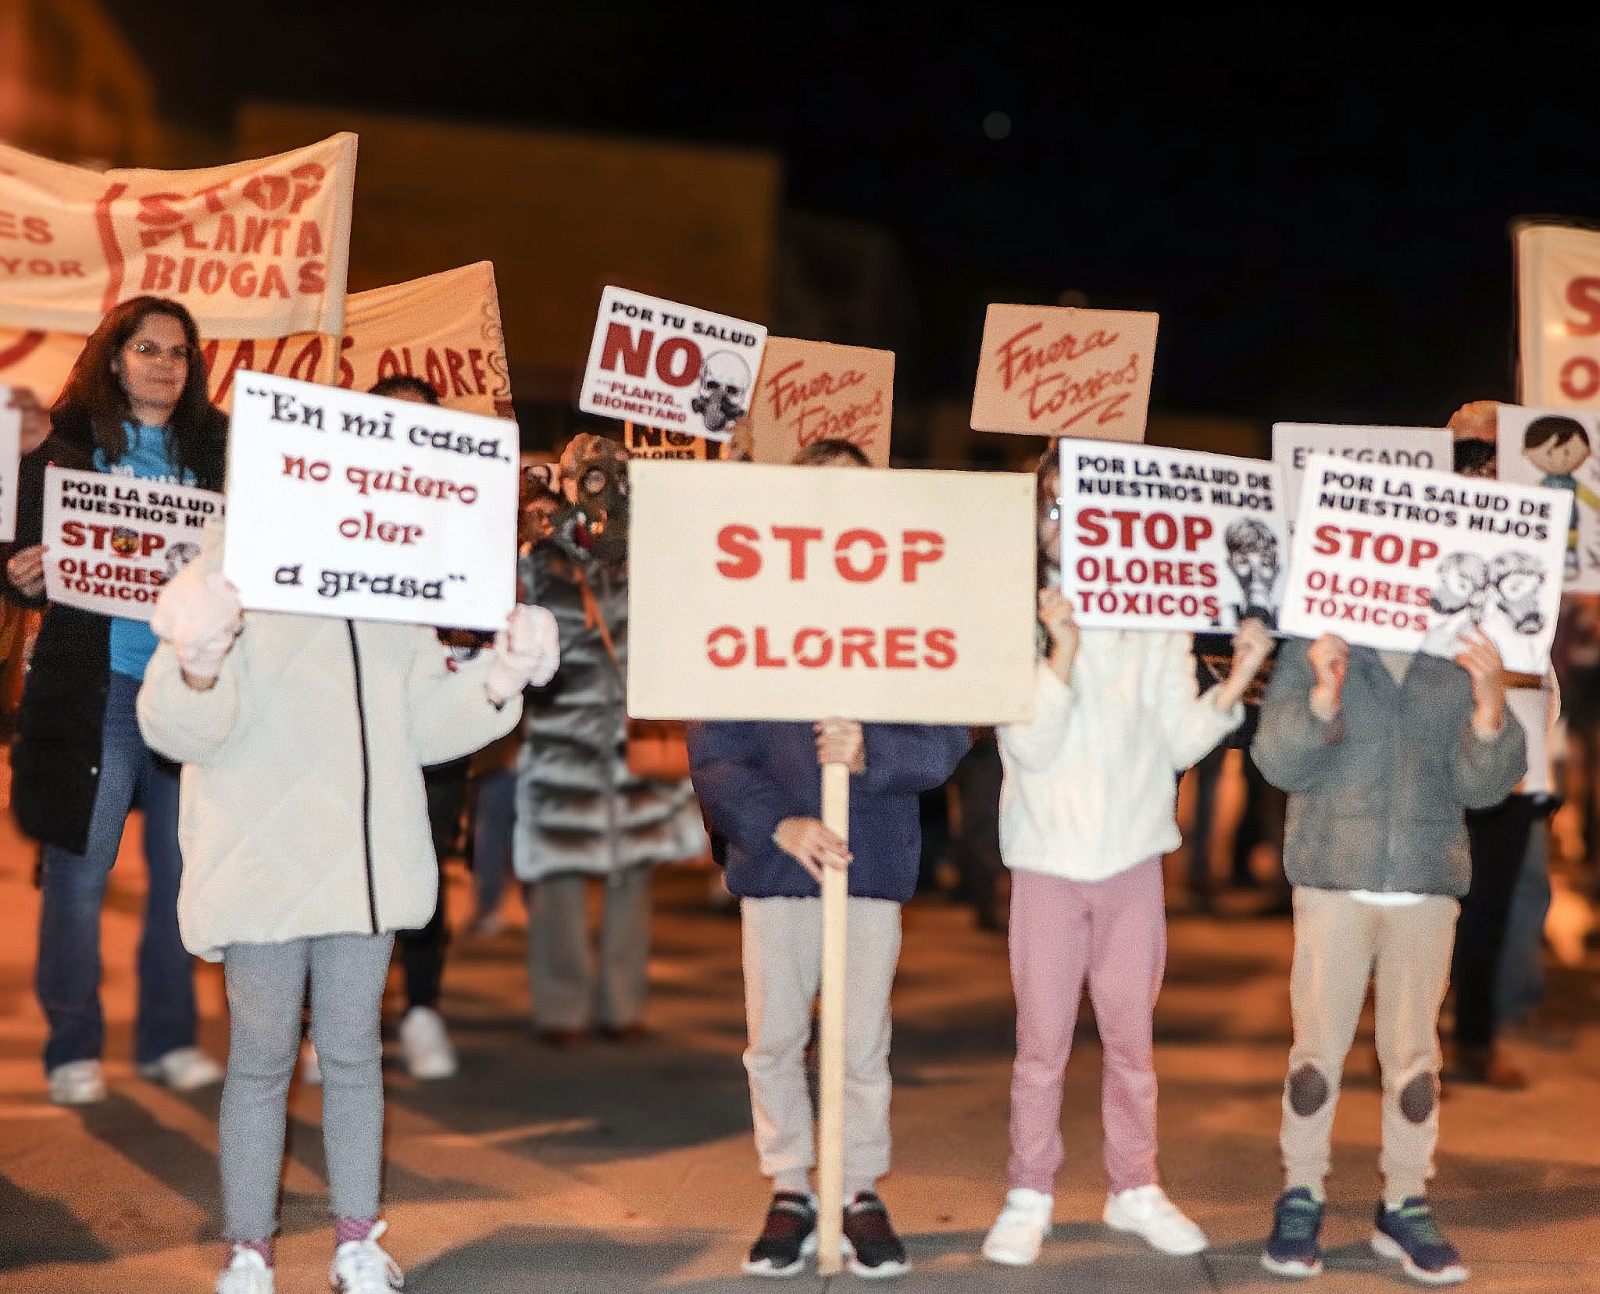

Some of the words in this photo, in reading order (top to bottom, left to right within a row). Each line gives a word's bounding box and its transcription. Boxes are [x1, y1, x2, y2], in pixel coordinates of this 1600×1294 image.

[136, 162, 326, 226] STOP
[139, 214, 323, 257] PLANTA
[140, 253, 326, 299] BIOGAS
[611, 302, 653, 322] POR
[660, 312, 686, 330] TU
[692, 321, 758, 348] SALUD
[600, 321, 704, 388] NO
[341, 411, 394, 440] mi
[592, 393, 688, 423] BIOMETANO
[282, 453, 331, 482] no
[346, 466, 479, 505] quiero
[1078, 456, 1126, 474] POR
[1134, 460, 1161, 478] LA
[1169, 463, 1240, 486] SALUD
[1247, 472, 1272, 491] DE
[61, 479, 107, 498] POR
[115, 486, 141, 502] LA
[148, 491, 215, 514] SALUD
[62, 496, 179, 525] NUESTROS
[1078, 477, 1203, 502] NUESTROS
[1211, 489, 1274, 511] HIJOS
[1322, 471, 1374, 493] POR
[1383, 479, 1413, 499] LA
[1424, 484, 1510, 513] SALUD
[1519, 501, 1552, 520] DE
[339, 510, 424, 545] oler
[1077, 507, 1214, 553] STOP
[1318, 492, 1458, 528] NUESTROS
[1468, 514, 1550, 541] HIJOS
[61, 519, 166, 558] STOP
[715, 523, 946, 584] STOP
[1313, 524, 1440, 568] STOP
[58, 557, 164, 587] OLORES
[274, 563, 304, 587] a
[1076, 556, 1218, 588] OLORES
[1306, 570, 1432, 608] OLORES
[1077, 584, 1220, 618] TÓXICOS
[706, 624, 959, 669] OLORES
